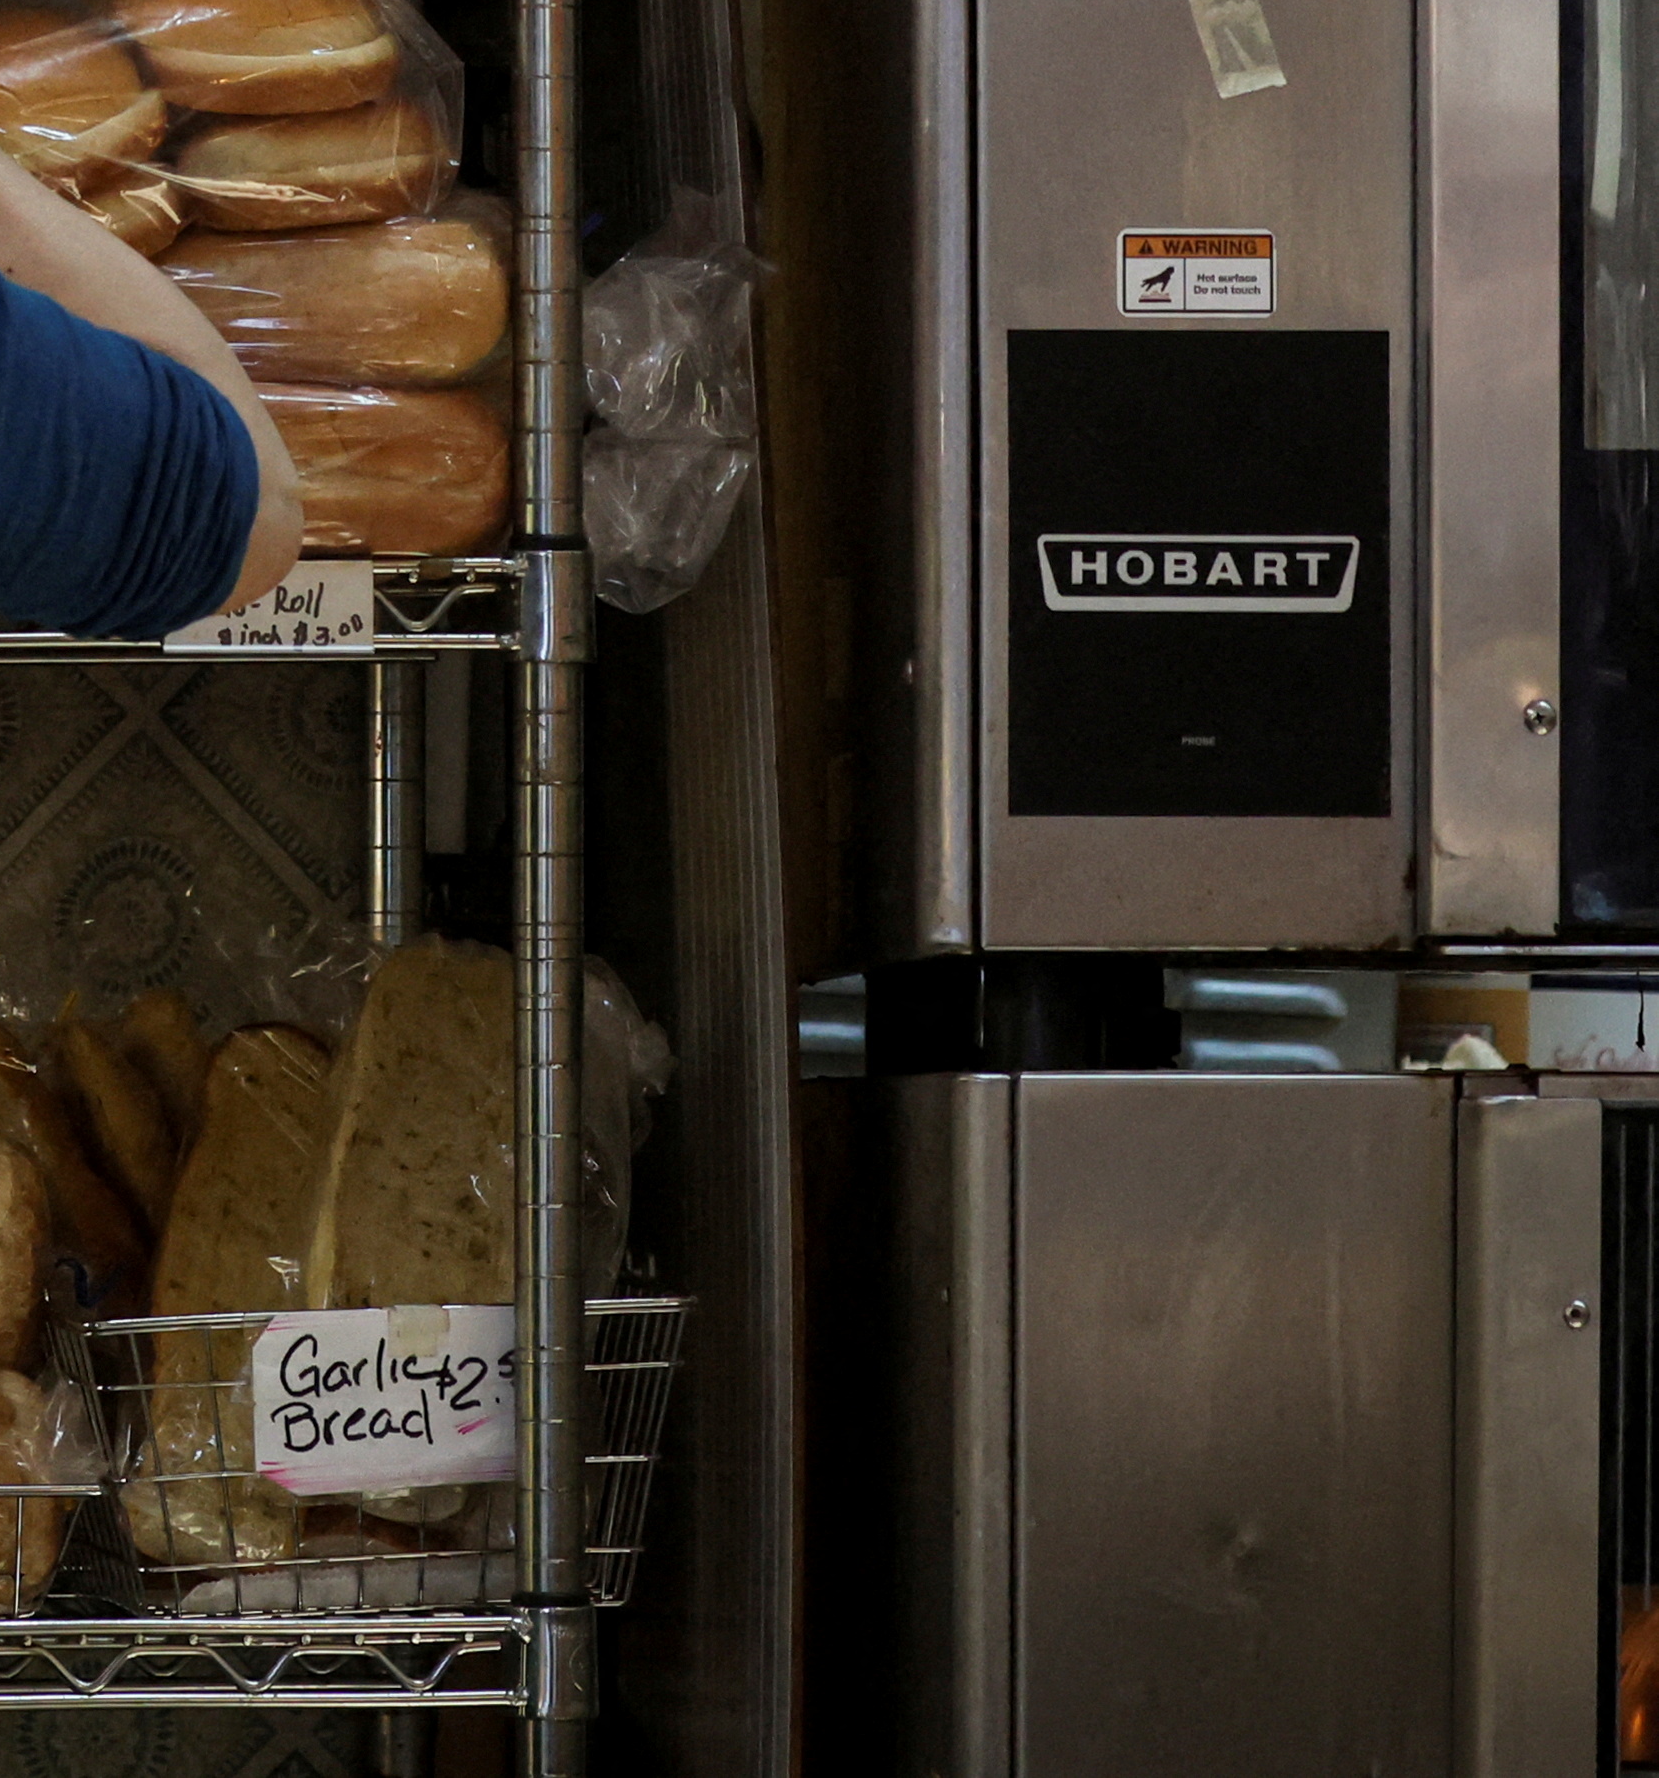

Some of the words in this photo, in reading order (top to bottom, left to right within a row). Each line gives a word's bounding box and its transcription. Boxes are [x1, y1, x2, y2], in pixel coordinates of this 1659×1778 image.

[1161, 238, 1259, 256] WARNING
[1193, 284, 1209, 295] Do
[1211, 284, 1228, 295] not
[1230, 284, 1262, 295] touch
[1196, 273, 1216, 283] Hot
[1218, 273, 1258, 283] surface
[1070, 549, 1331, 587] HOBART
[273, 581, 324, 618] Roll
[239, 623, 283, 647] inch
[279, 1333, 437, 1398] Garlic
[269, 1388, 434, 1453] Bread
